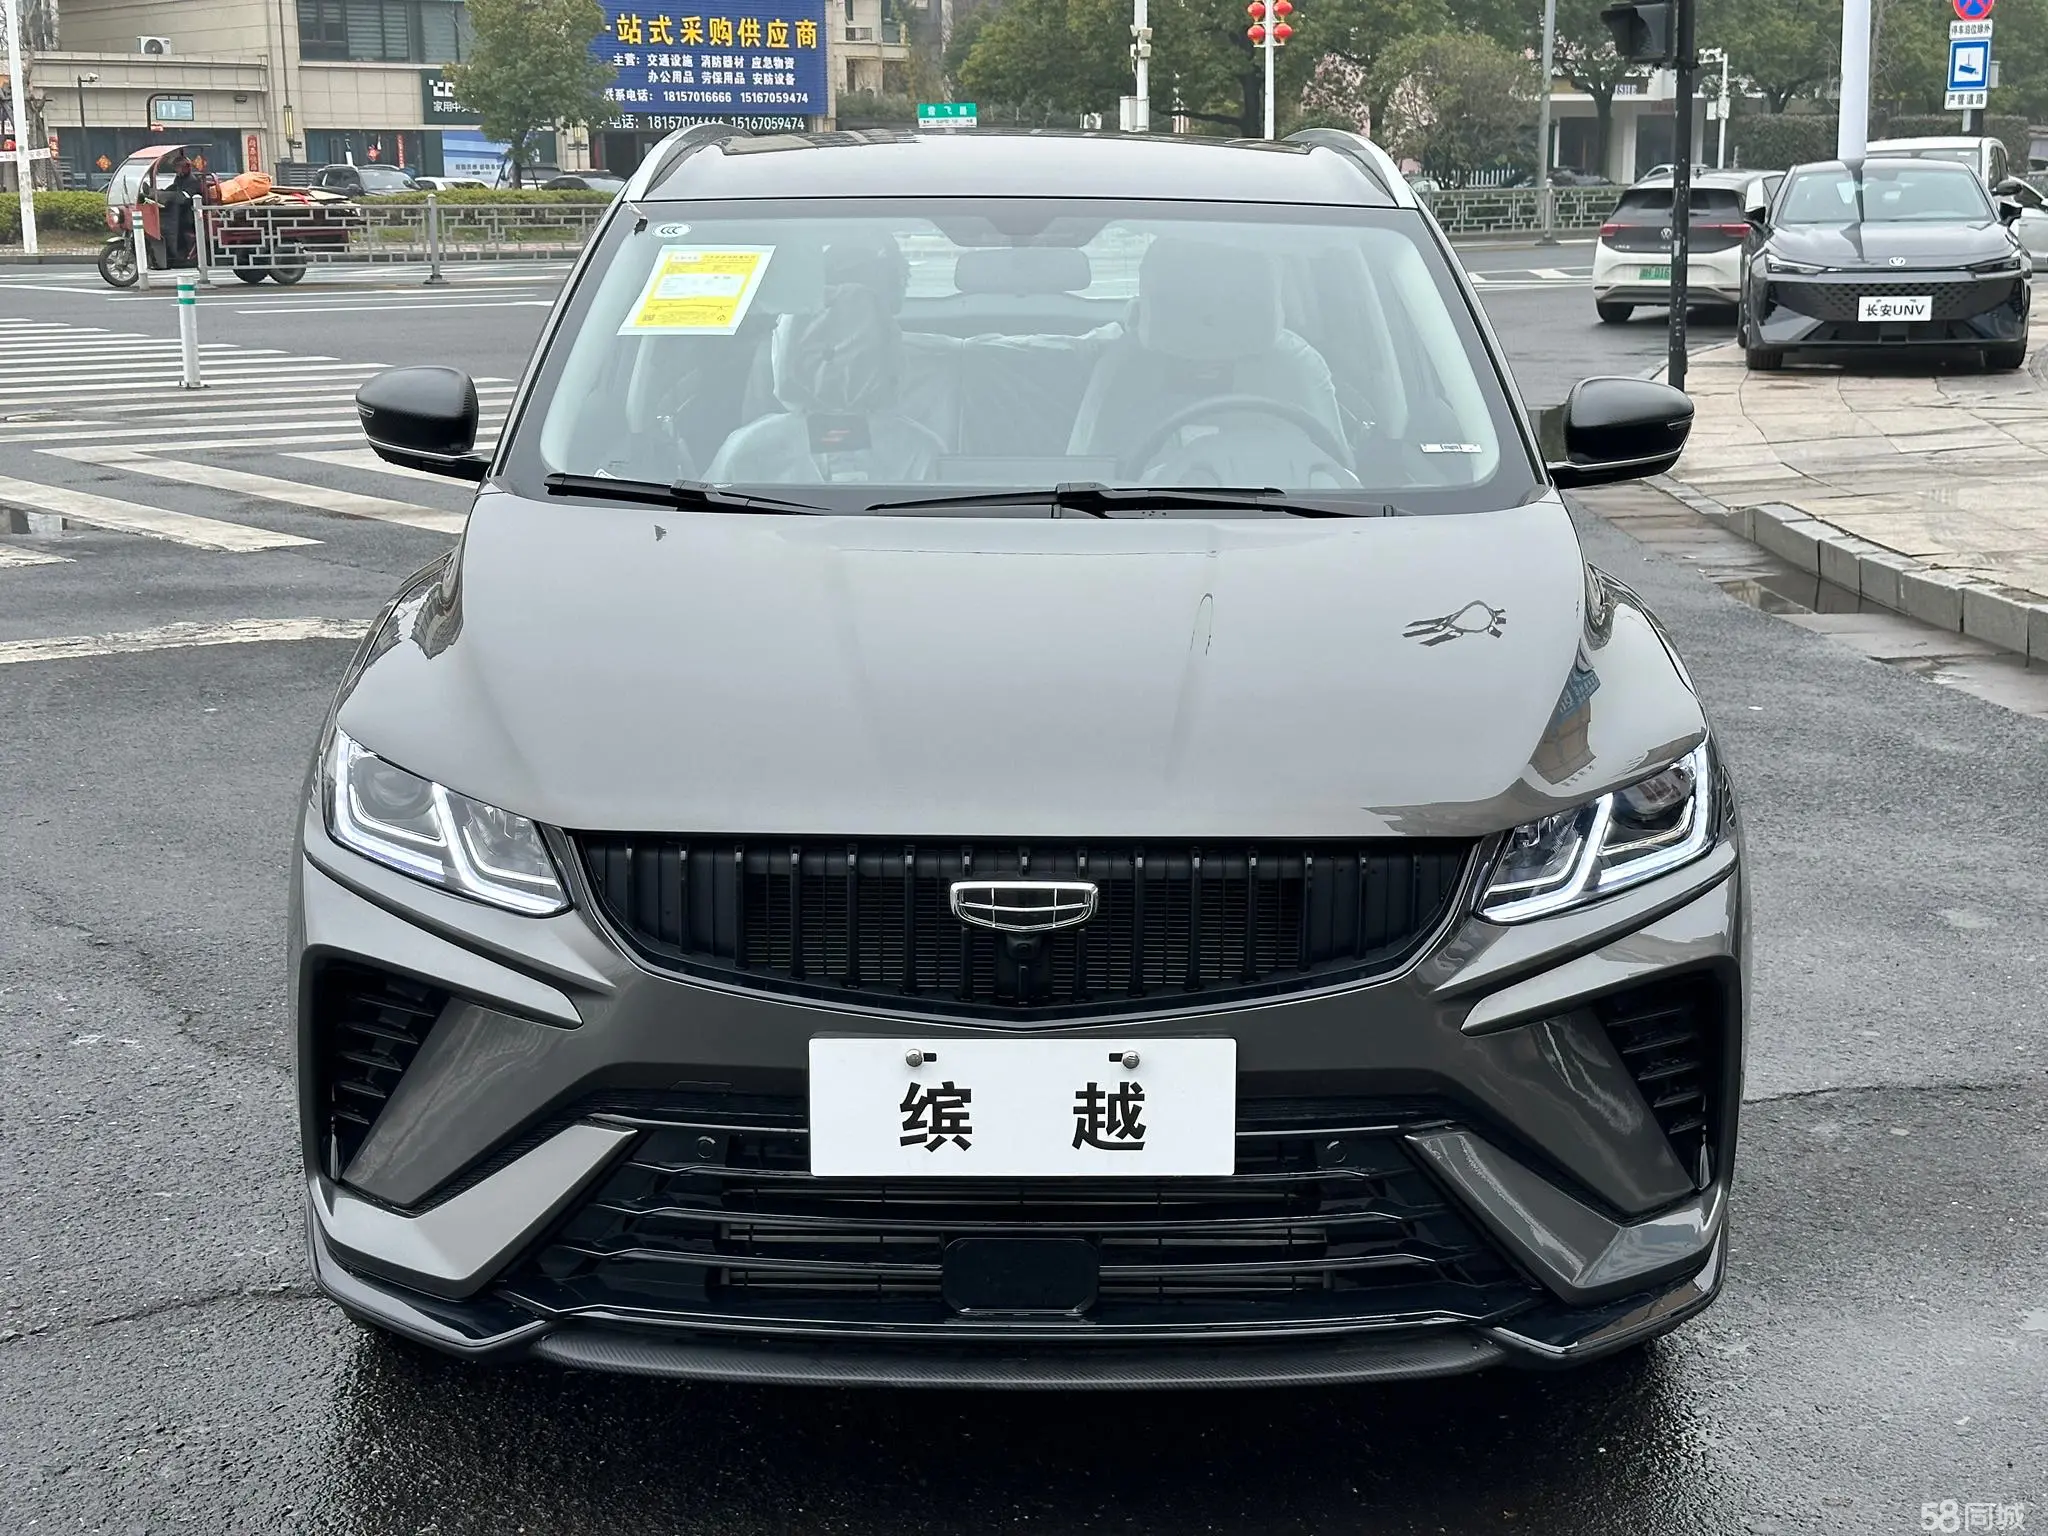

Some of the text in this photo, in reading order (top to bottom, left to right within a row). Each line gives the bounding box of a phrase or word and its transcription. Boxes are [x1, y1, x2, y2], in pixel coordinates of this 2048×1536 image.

[605, 13, 817, 48] 站式采购供应商
[647, 53, 693, 68] 交通设施
[700, 55, 744, 69] 消防器材
[751, 56, 795, 70] 应急物资
[648, 69, 796, 86] 办公用品 劳保用品 安防设备
[663, 90, 732, 103] 18157016666
[740, 91, 809, 104] 15167059474
[731, 116, 805, 130] 15167059474
[1865, 304, 1925, 316] 长安UNV
